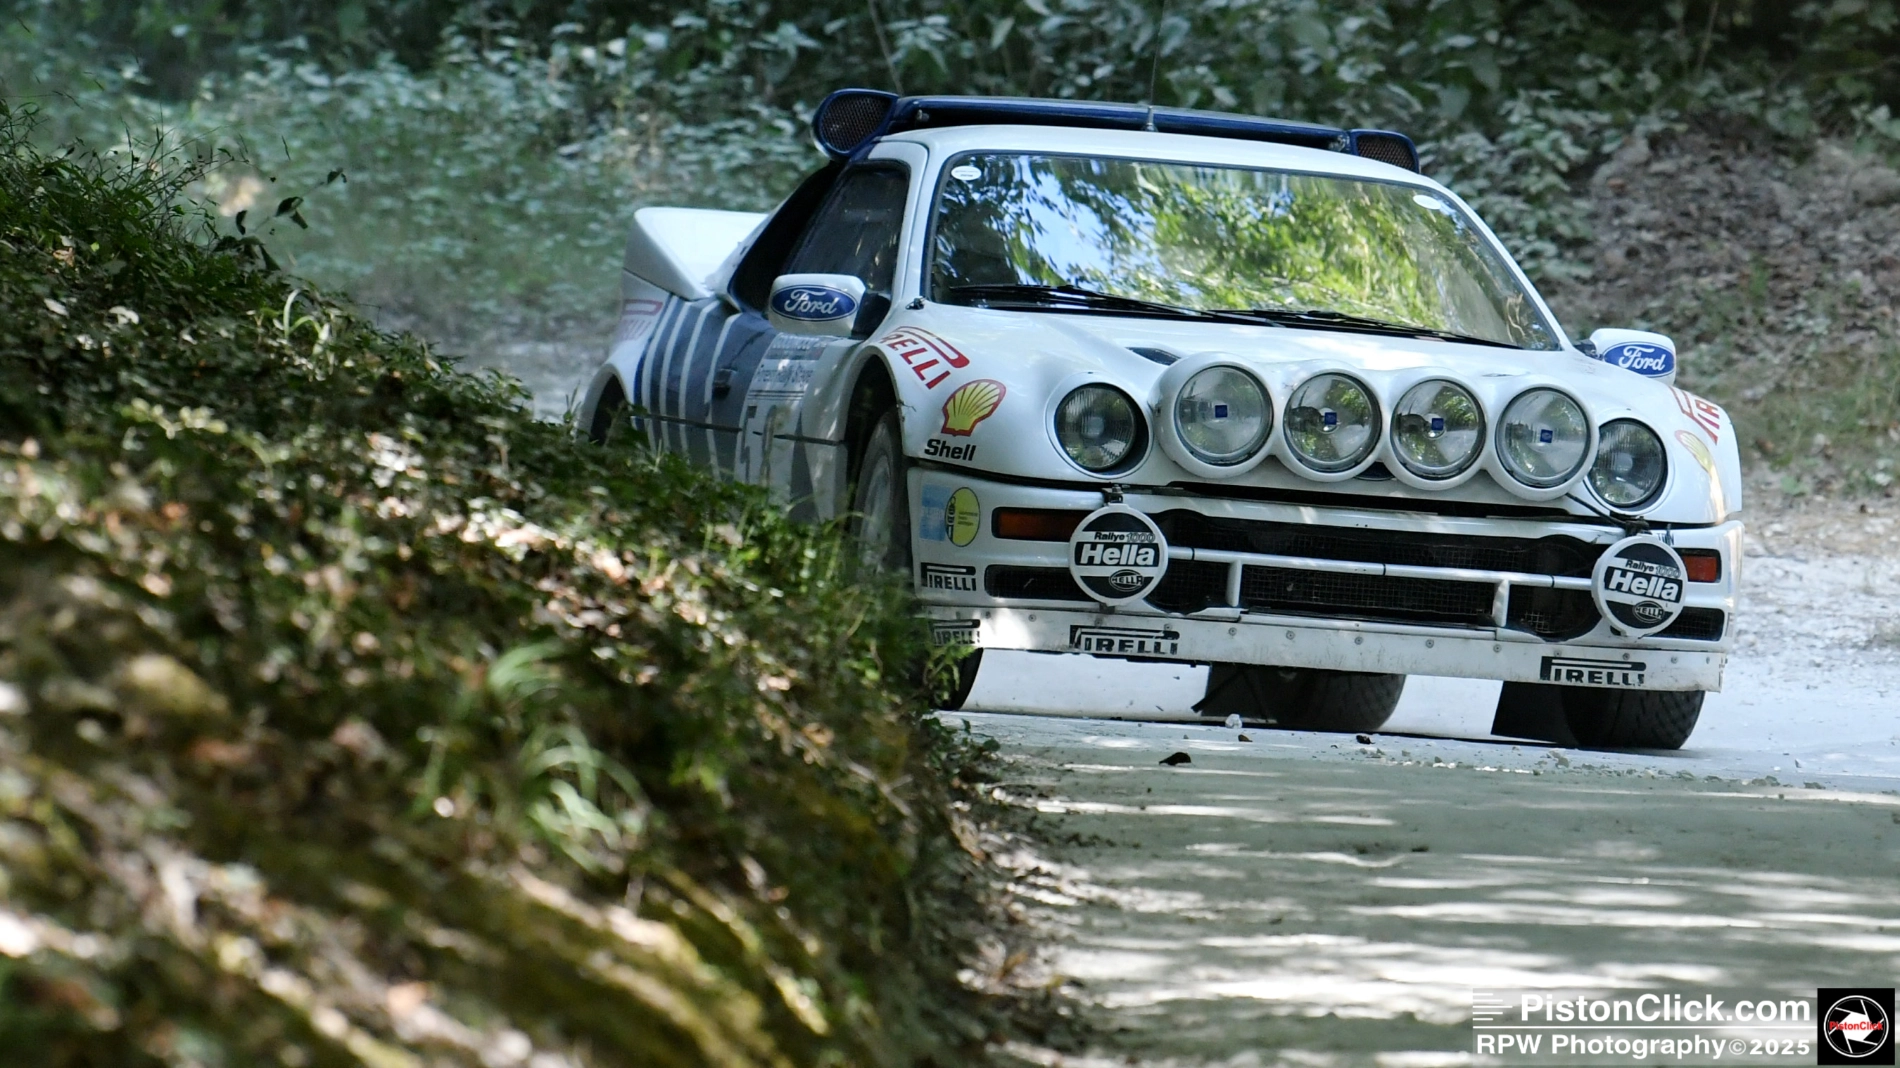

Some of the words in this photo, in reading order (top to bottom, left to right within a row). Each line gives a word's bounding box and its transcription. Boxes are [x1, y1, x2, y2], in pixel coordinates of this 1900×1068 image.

[784, 289, 839, 315] Ford
[1618, 345, 1667, 371] Ford
[924, 438, 977, 461] Shell
[1094, 531, 1125, 542] Rallye
[1126, 532, 1156, 543] 1000
[1079, 543, 1155, 566] Hella
[1625, 559, 1655, 573] Rallye
[921, 562, 977, 591] PIRELLI
[1111, 575, 1143, 587] HELLA
[1608, 569, 1679, 601] Hella
[1635, 606, 1664, 620] HELLA
[1068, 624, 1180, 655] PIRELLI
[1539, 656, 1647, 687] PIRELLI
